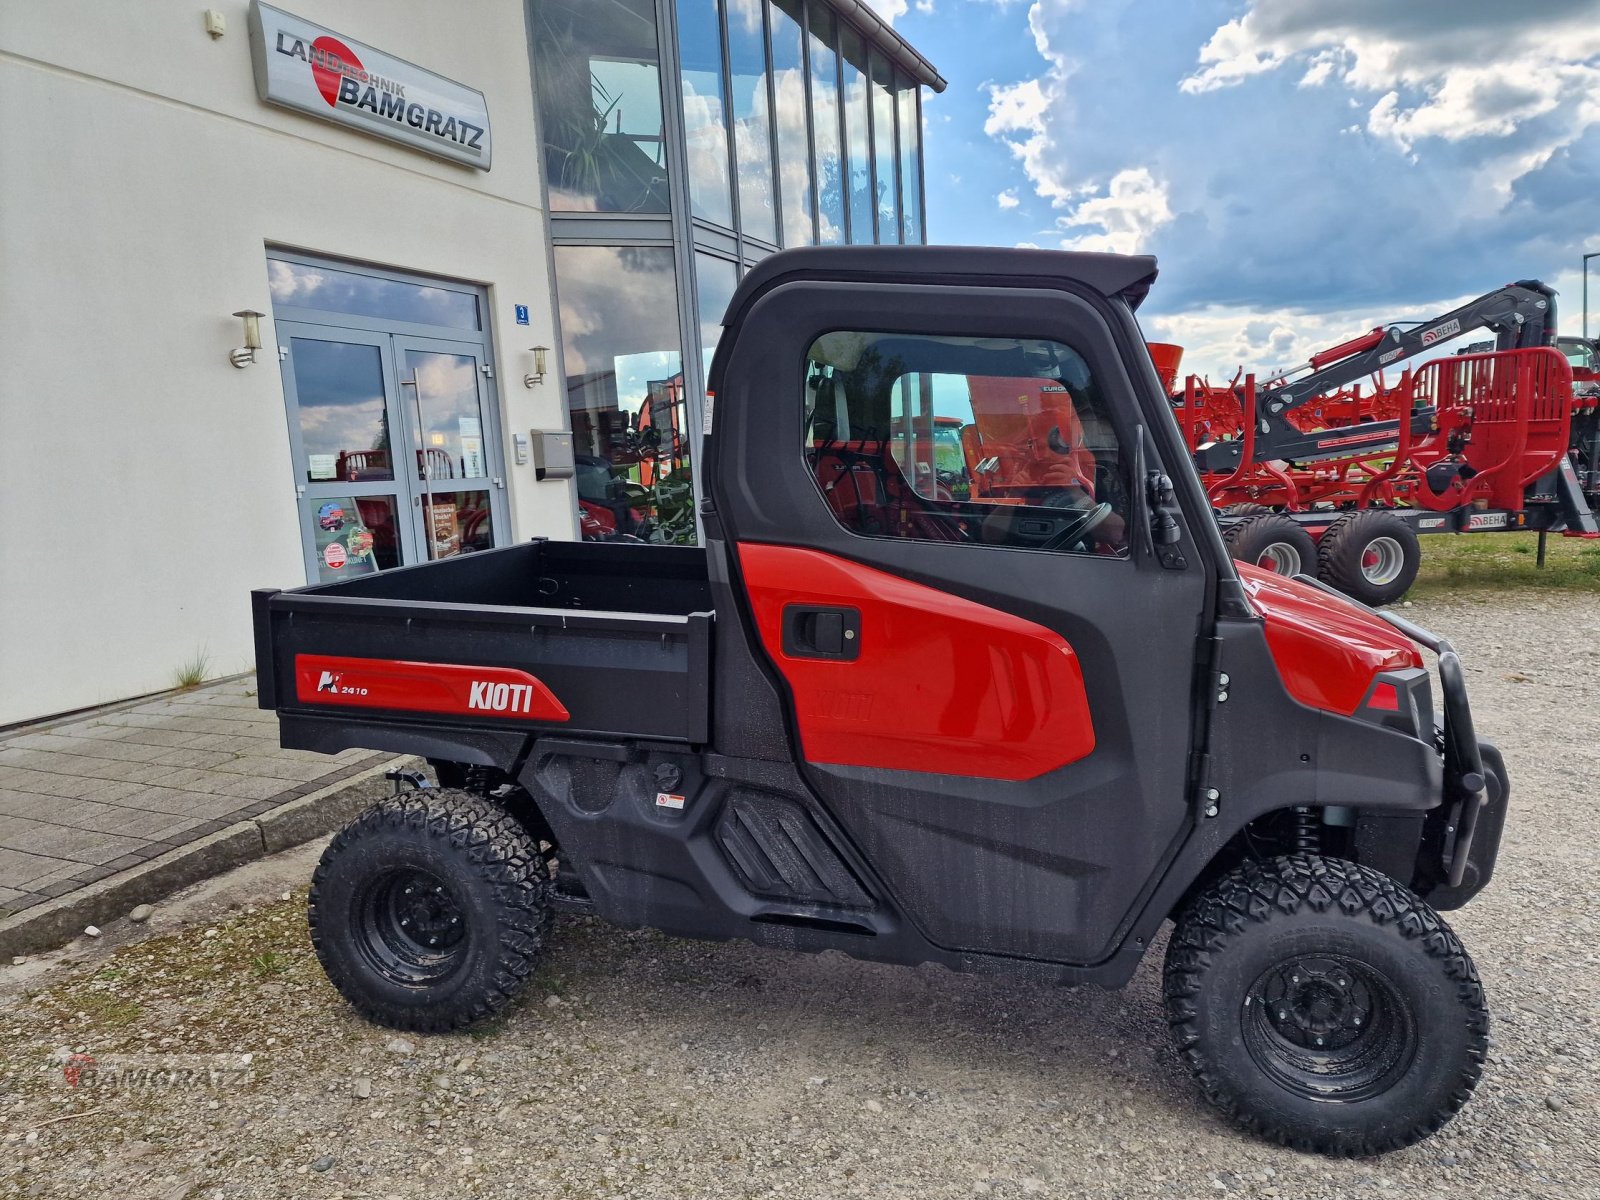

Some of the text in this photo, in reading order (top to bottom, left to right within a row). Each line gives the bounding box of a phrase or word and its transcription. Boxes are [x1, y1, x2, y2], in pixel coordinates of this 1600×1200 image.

[276, 33, 405, 96] LANDTECHNIK
[338, 77, 485, 150] BAMGRATZ
[519, 306, 526, 319] 3
[1436, 321, 1461, 338] BEHA
[1482, 515, 1506, 526] BEHA
[341, 687, 368, 697] 2410
[468, 681, 534, 713] KIOTI
